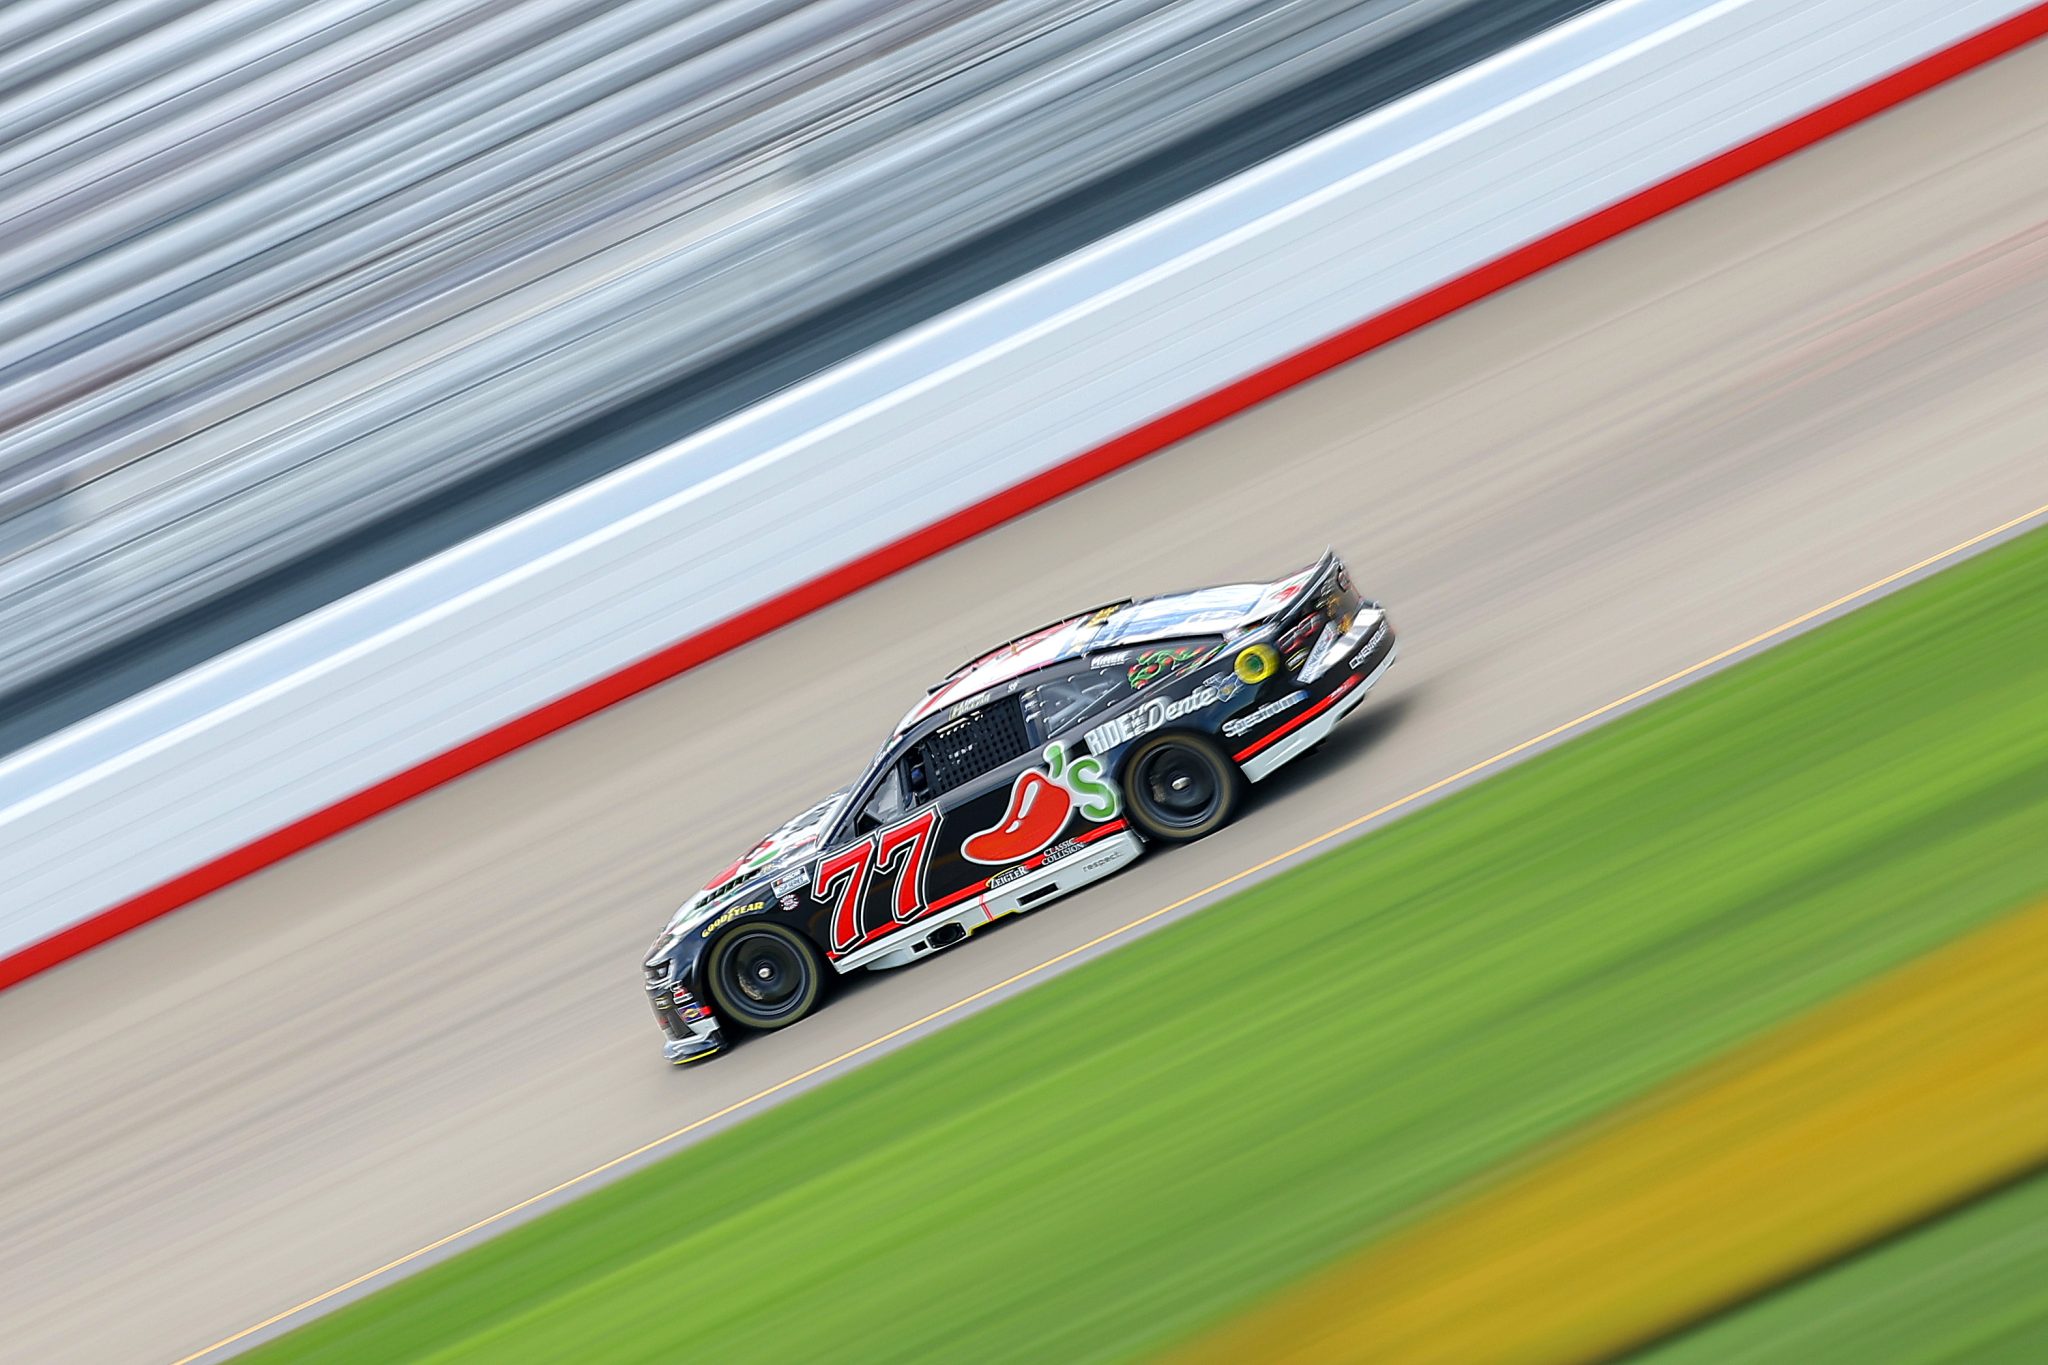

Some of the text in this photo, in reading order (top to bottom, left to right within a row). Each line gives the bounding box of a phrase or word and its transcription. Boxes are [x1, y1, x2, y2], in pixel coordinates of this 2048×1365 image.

[1222, 691, 1299, 738] Spectrum
[1084, 713, 1133, 757] RIDE
[1041, 842, 1085, 866] COLLISION
[1043, 838, 1077, 857] CLASSIC
[811, 803, 943, 954] 77
[990, 865, 1028, 889] ZEIGLER
[701, 901, 766, 938] GOODYEAR
